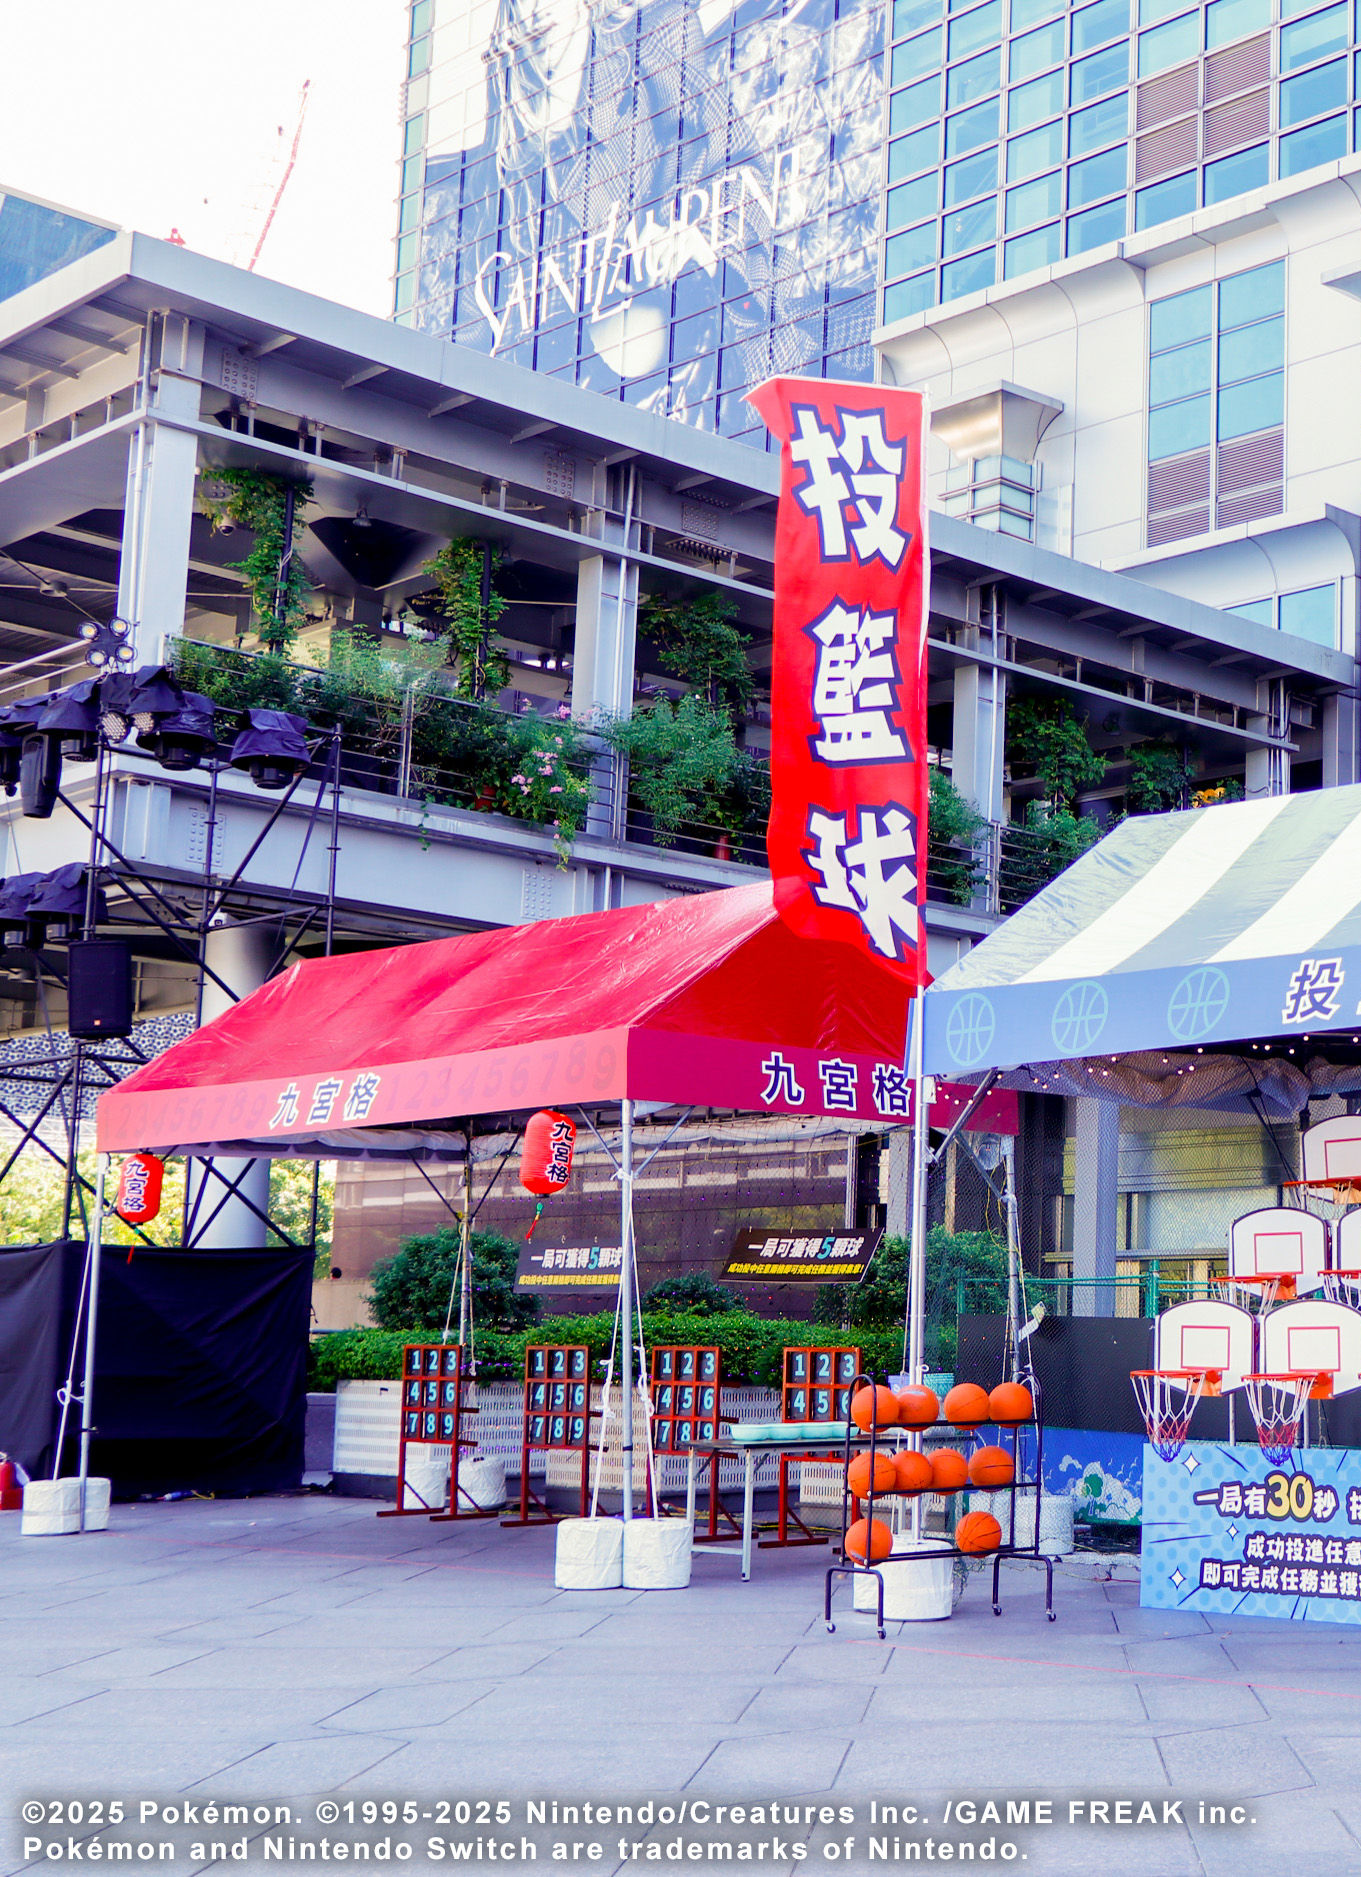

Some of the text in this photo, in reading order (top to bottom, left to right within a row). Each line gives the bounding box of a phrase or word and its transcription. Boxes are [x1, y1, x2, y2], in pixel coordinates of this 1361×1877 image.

[474, 232, 607, 357] SAINT
[790, 403, 923, 961] 投籃球
[760, 1051, 912, 1117] 九宮格
[268, 1071, 382, 1130] 九宮格
[545, 1120, 574, 1183] 九宮格
[122, 1160, 150, 1213] 九宮格
[412, 1350, 457, 1372] 1 2 3
[535, 1351, 585, 1373] 1 2 3
[662, 1352, 715, 1376] 1 2 3
[794, 1354, 855, 1379] 1 2 3
[409, 1381, 455, 1403] 4 5 6
[535, 1384, 585, 1407] 4 5 6
[660, 1387, 715, 1411] 4 5 6
[793, 1390, 848, 1415] 4 5 6
[409, 1413, 454, 1435] 7 8 9
[535, 1417, 584, 1440] 7 8 9
[661, 1421, 713, 1443] 7 8 9
[1195, 1473, 1338, 1520] 一局有30秒
